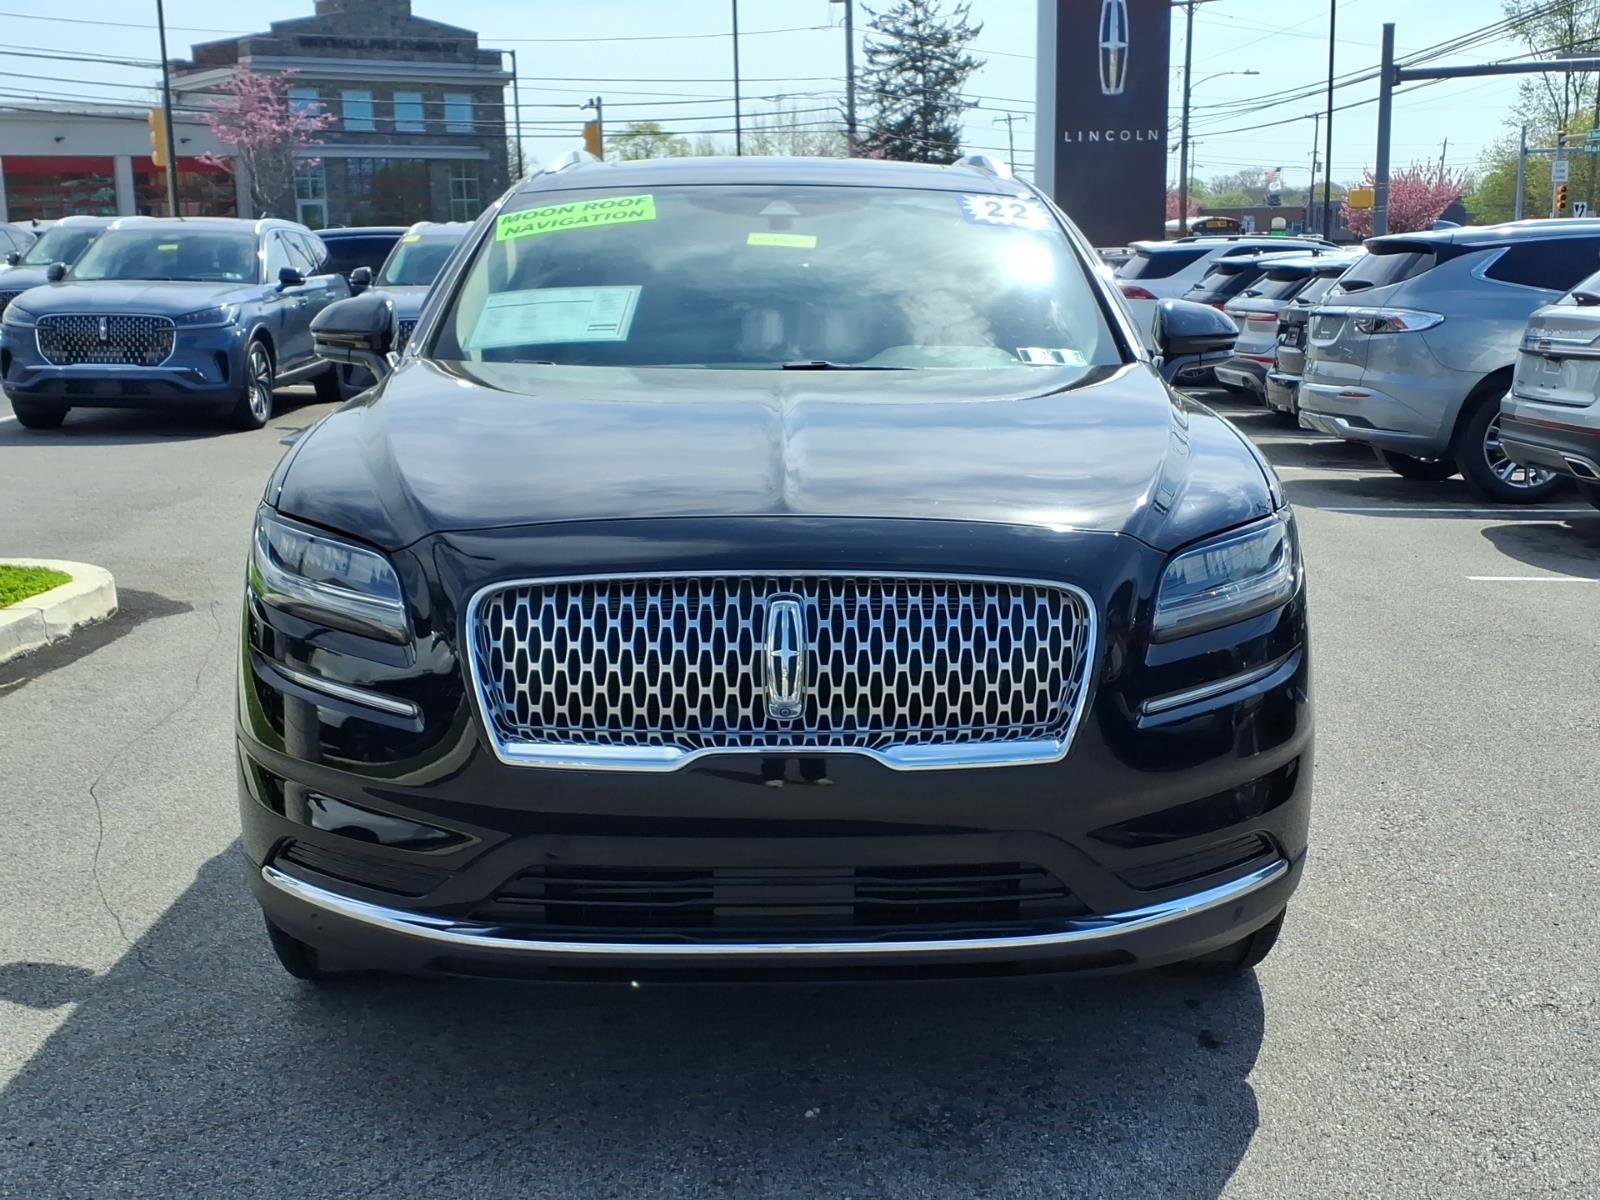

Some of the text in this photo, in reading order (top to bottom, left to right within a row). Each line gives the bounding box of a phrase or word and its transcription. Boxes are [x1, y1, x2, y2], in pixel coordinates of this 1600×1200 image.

[1064, 130, 1159, 142] LINCOLN
[502, 197, 649, 225] MOON ROOF
[984, 201, 1029, 220] 22
[504, 209, 645, 236] NAVIGATION
